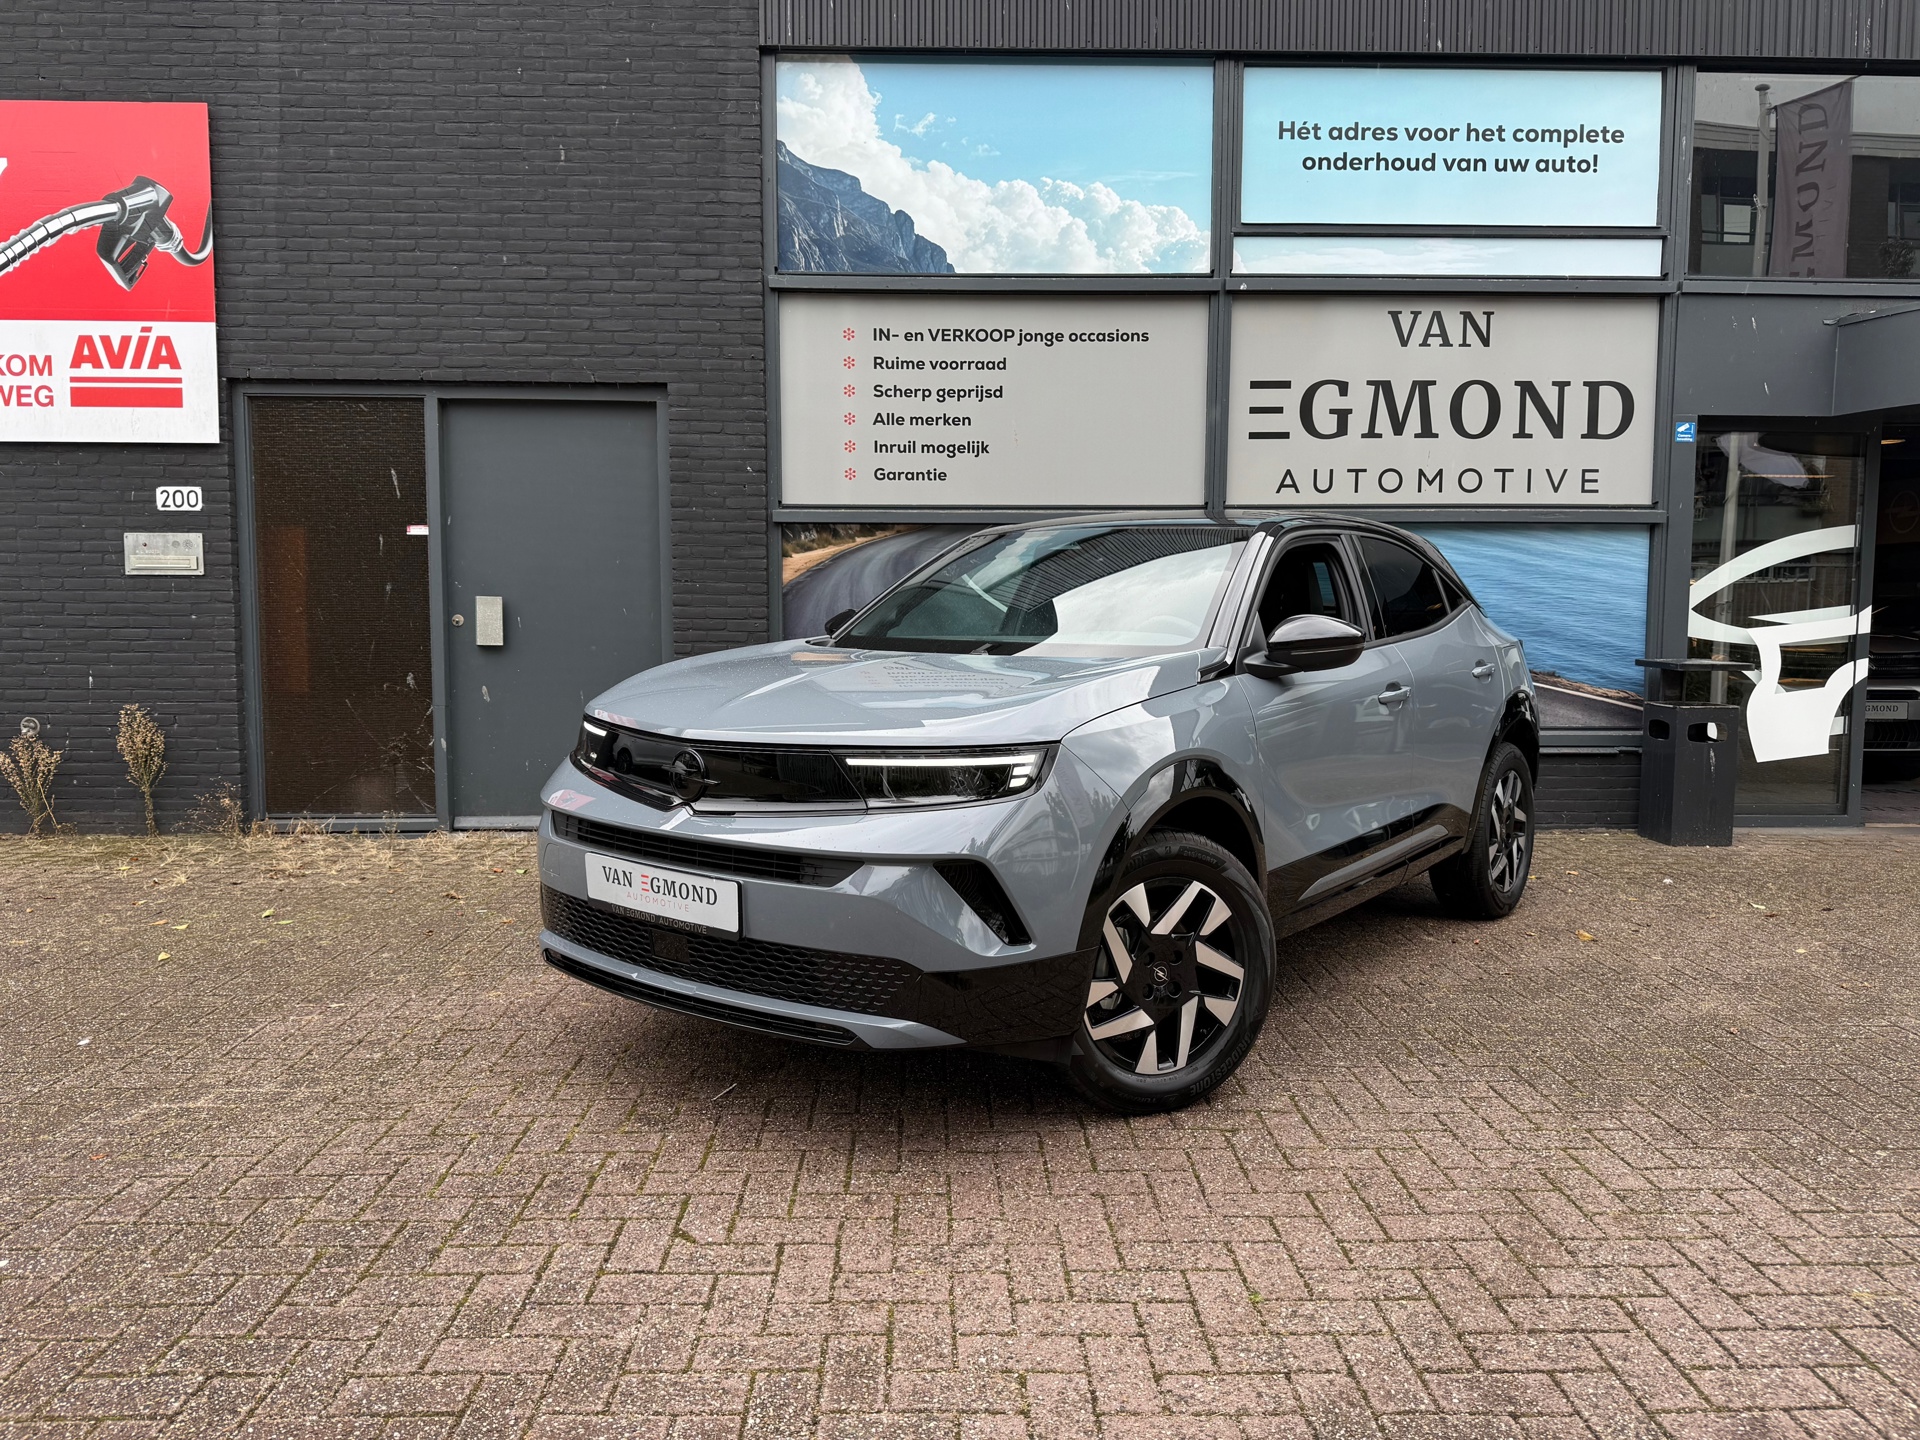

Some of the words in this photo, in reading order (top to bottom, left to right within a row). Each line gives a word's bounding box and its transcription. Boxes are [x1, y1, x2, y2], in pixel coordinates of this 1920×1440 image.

[1278, 121, 1322, 141] Hét
[1328, 121, 1398, 142] adres
[1404, 124, 1460, 142] voor
[1466, 123, 1506, 143] het
[1512, 124, 1625, 149] complete
[1302, 152, 1436, 172] onderhoud
[1443, 155, 1487, 172] van
[1494, 156, 1530, 173] uw
[1535, 154, 1599, 173] auto!
[1789, 103, 1829, 278] MOND
[872, 328, 900, 342] IN-
[903, 331, 924, 342] en
[928, 328, 1015, 342] VERKOOP
[1017, 328, 1064, 347] jonge
[1068, 328, 1150, 343] occasions
[1388, 310, 1495, 348] VAN
[872, 356, 926, 370] Ruime
[929, 356, 1007, 371] voorraad
[872, 384, 932, 402] Scherp
[936, 384, 1004, 403] geprijsd
[872, 412, 905, 426] Alle
[909, 412, 972, 427] merken
[1248, 378, 1635, 440] EGMOND
[873, 440, 917, 454] Inruil
[921, 440, 990, 459] mogelijk
[873, 467, 948, 482] Garantie
[1275, 467, 1599, 494] AUTOMOTIVE
[160, 489, 199, 508] 200
[602, 865, 633, 889] VAN
[640, 873, 718, 906] EGMOND
[626, 891, 690, 912] AUTOMOTIVE
[611, 904, 625, 916] VAN
[659, 916, 707, 935] AUTOMOTIVE
